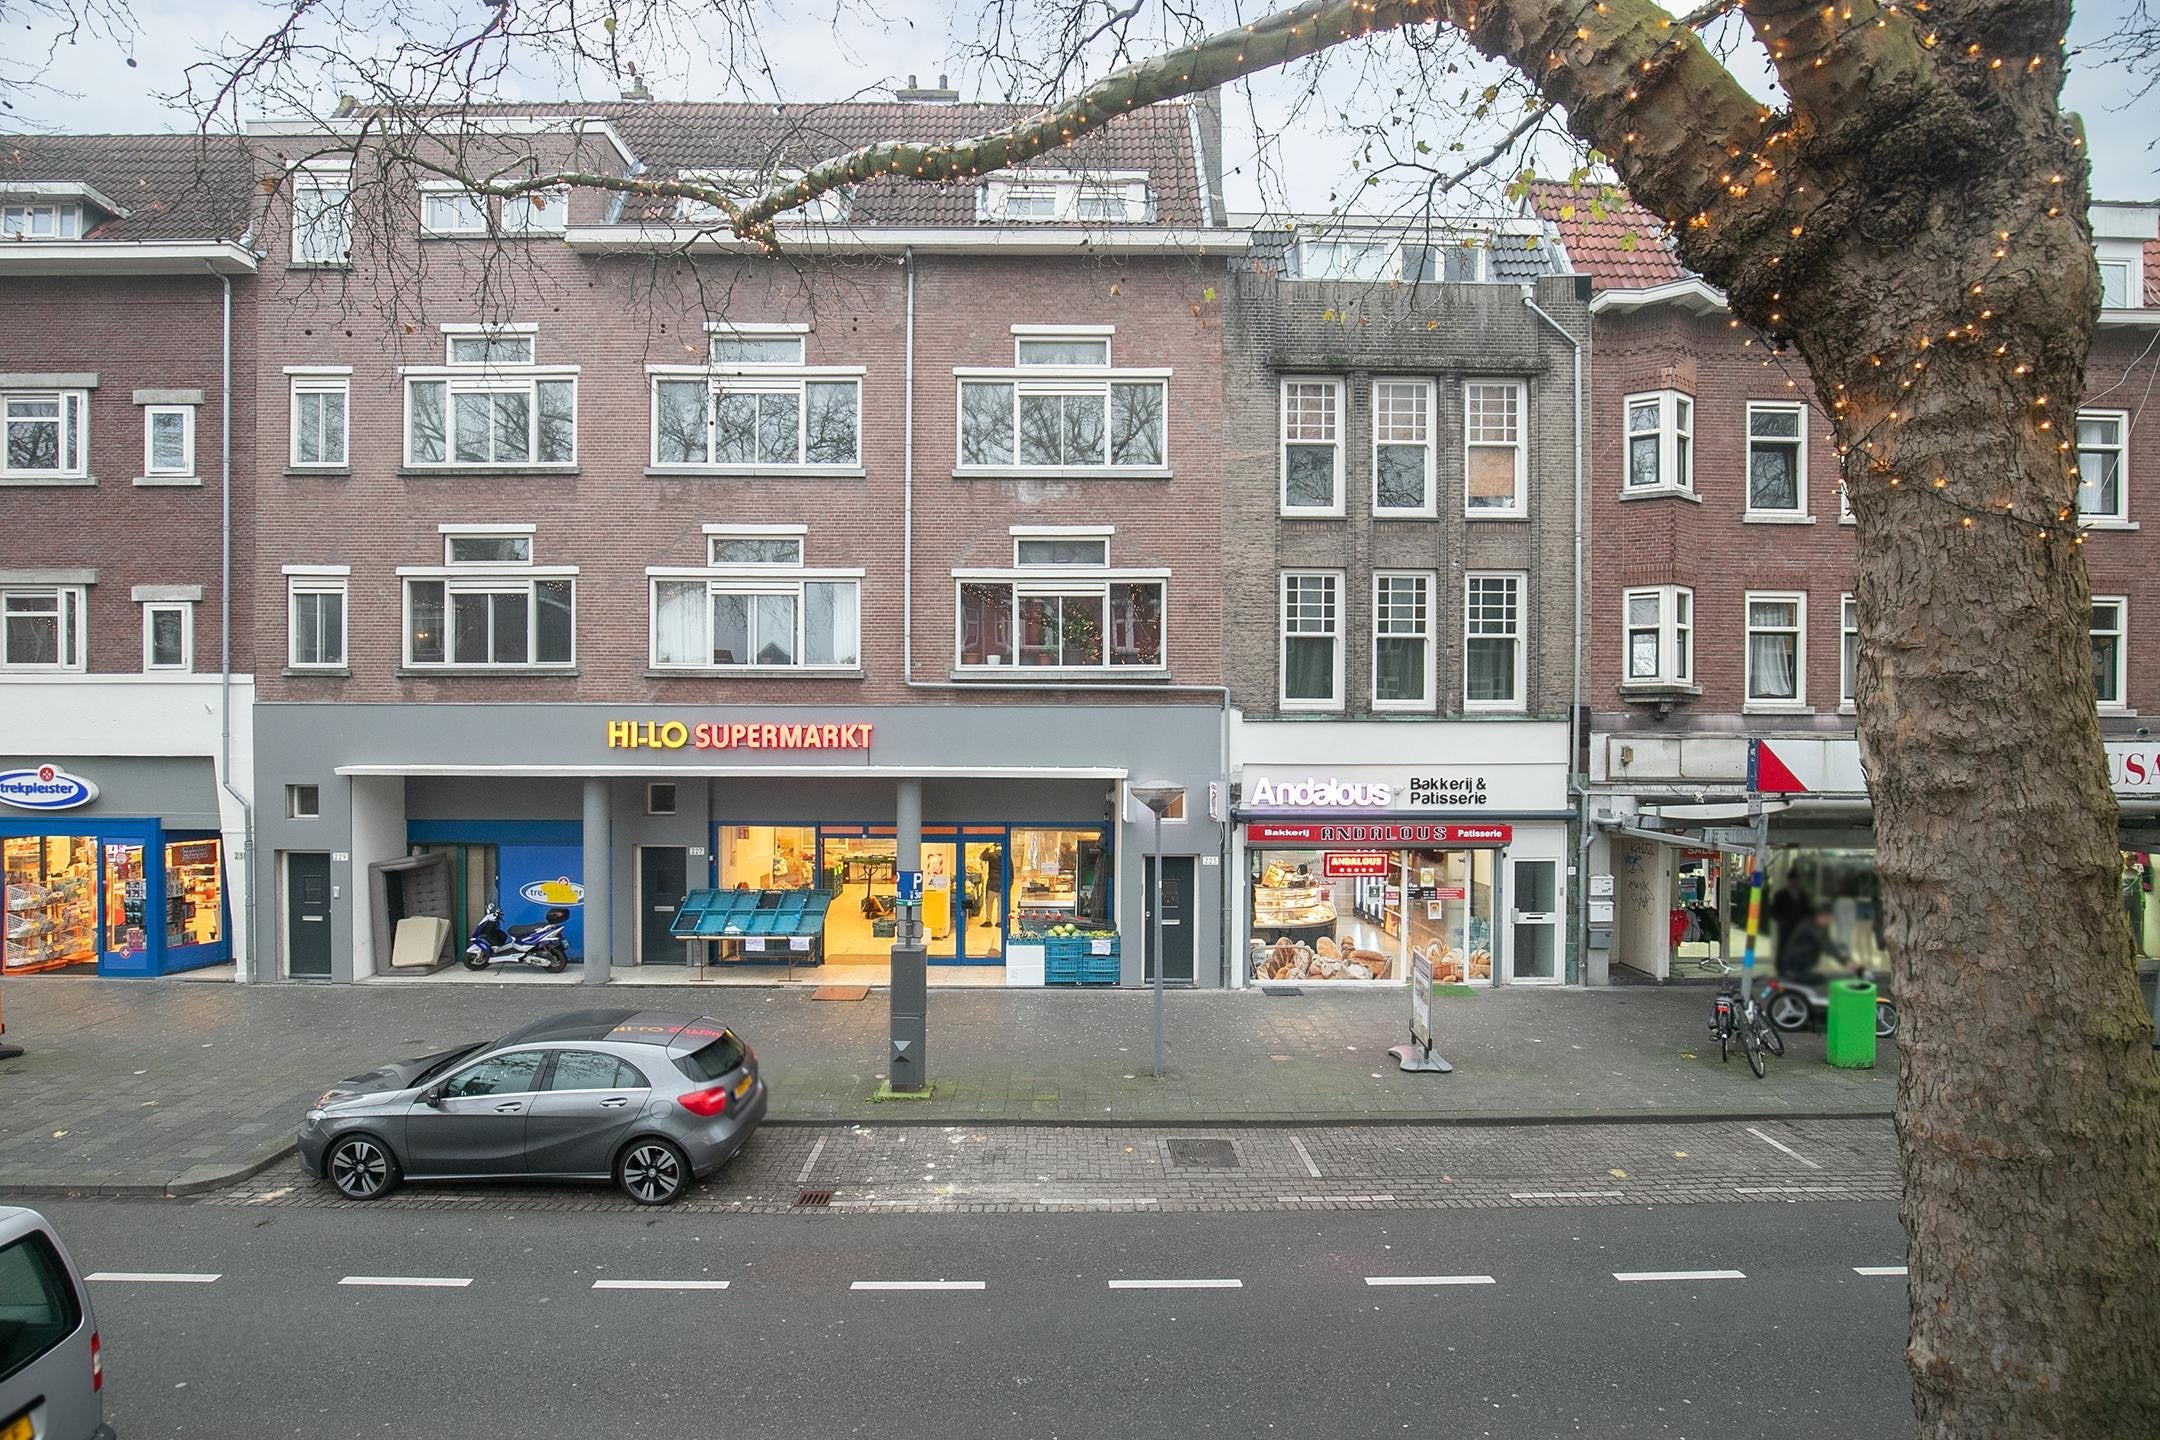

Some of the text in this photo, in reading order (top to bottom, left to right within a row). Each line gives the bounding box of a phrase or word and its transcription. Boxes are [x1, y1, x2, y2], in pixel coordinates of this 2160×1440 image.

[607, 720, 873, 748] HI-LO SUPERMARKT
[0, 782, 74, 796] trekpleister
[1250, 776, 1391, 807] Andalous
[1410, 777, 1487, 794] Bakkerij &
[1410, 792, 1487, 805] Patisserie
[1264, 826, 1503, 841] Bakkerij ANDALOUS Patisserie
[1330, 857, 1384, 867] ANDALOUS
[913, 872, 923, 889] P
